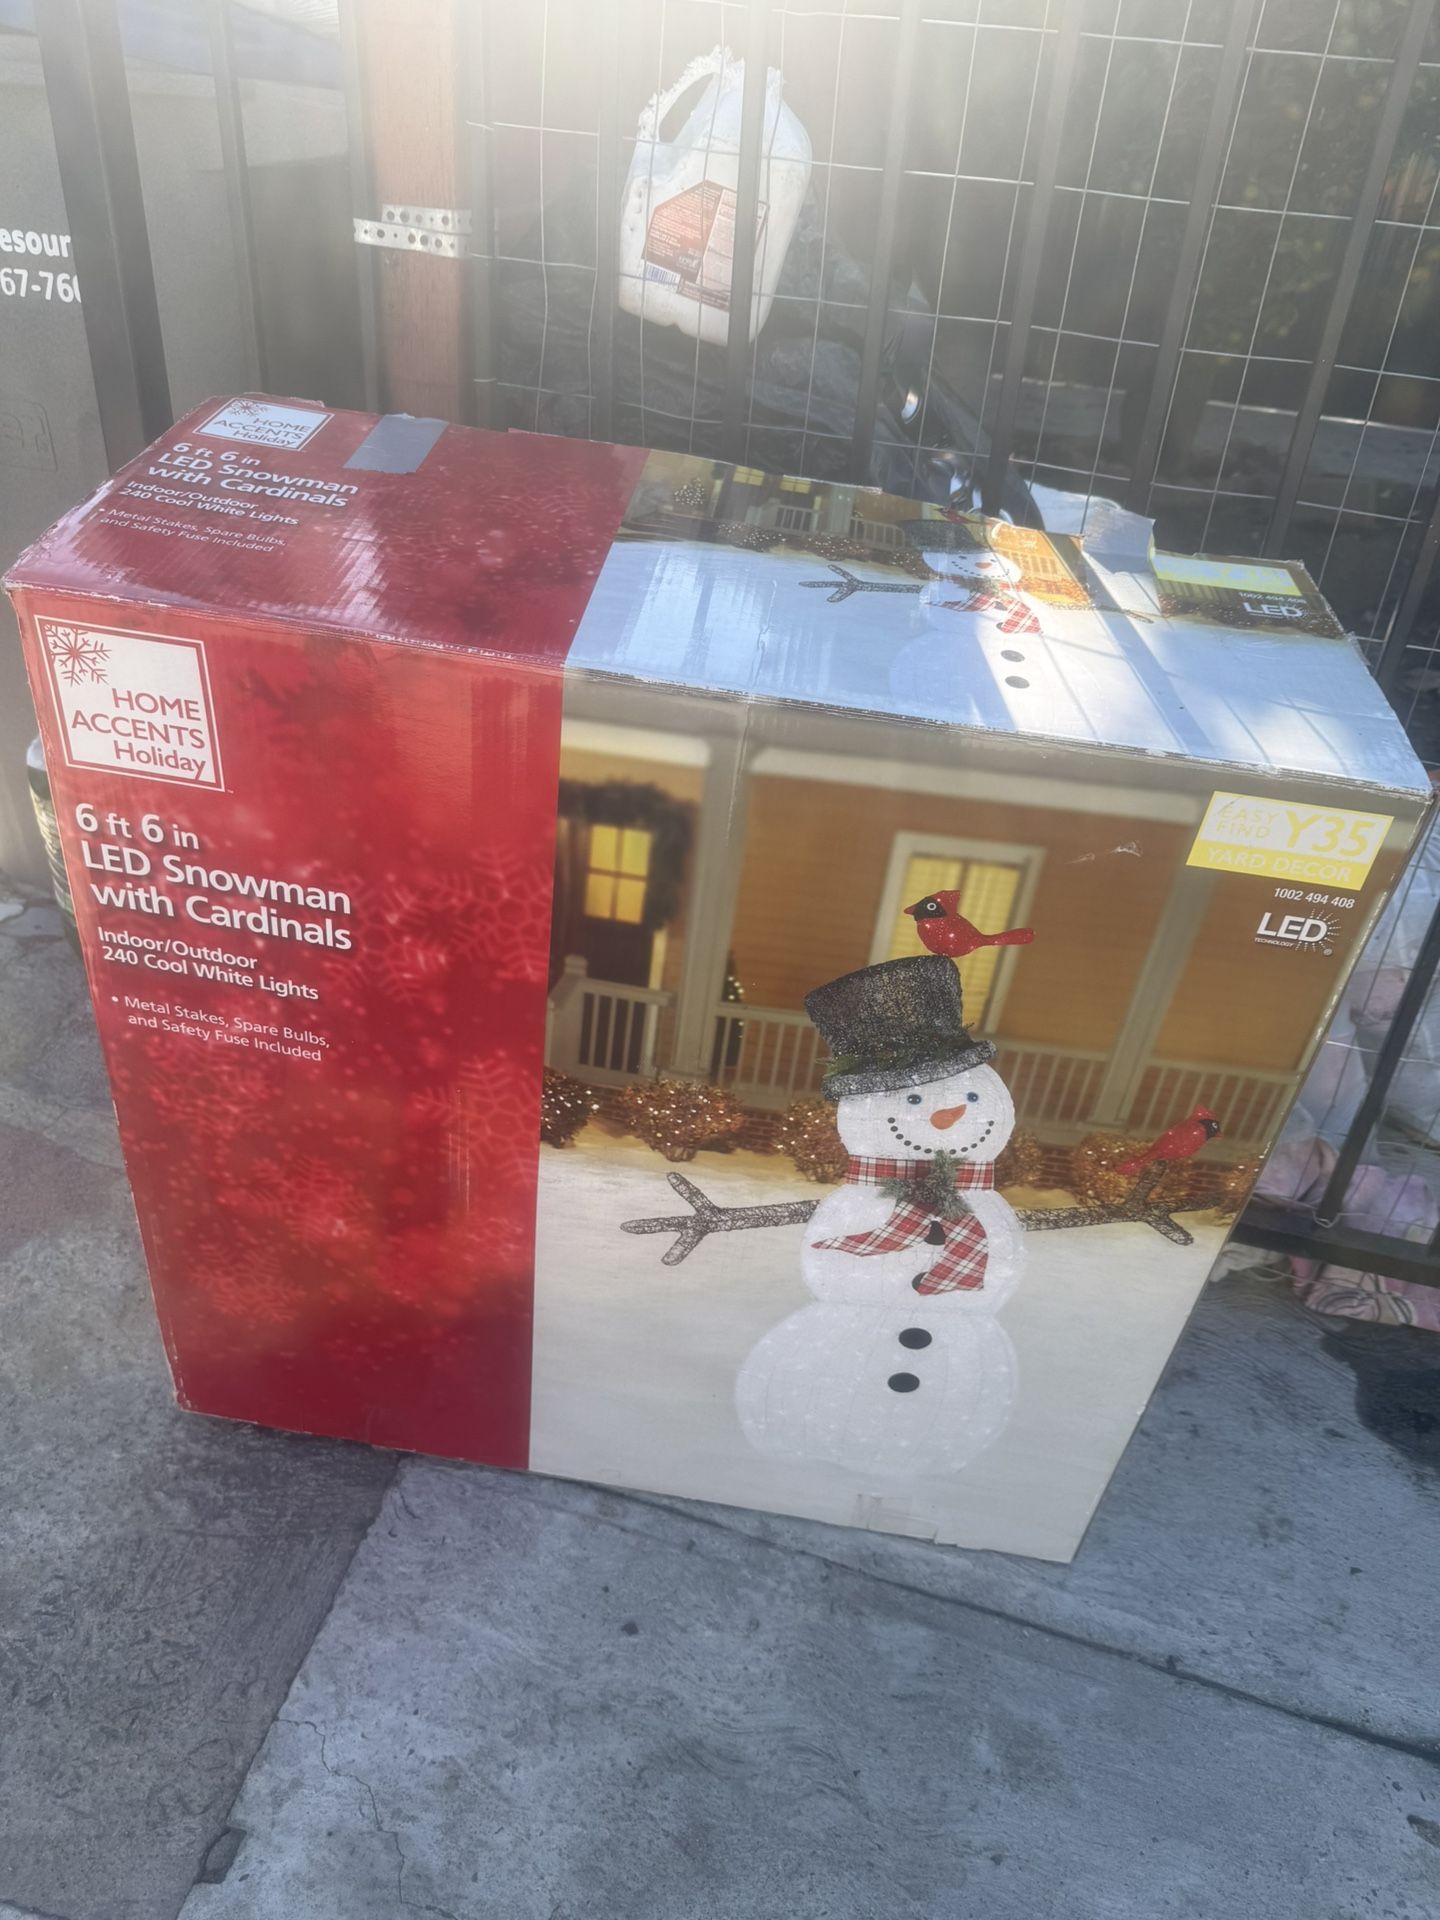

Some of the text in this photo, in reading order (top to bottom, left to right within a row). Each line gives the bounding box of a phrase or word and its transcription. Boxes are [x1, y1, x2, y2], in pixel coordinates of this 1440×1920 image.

[214, 419, 304, 440] ACCENTS
[233, 430, 297, 447] Holiday
[253, 418, 311, 432] HOME
[157, 453, 359, 495] LED Snowman
[173, 443, 261, 467] 6 ft 6 in
[127, 480, 259, 509] Indoor/Outdoor
[148, 466, 348, 507] with Cardinals
[119, 488, 299, 526] 240 Cool White Lights
[100, 517, 274, 552] and Safety Fuse Included
[108, 508, 287, 547] Metal Stakes, Spare Bulbs,
[1243, 602, 1302, 617] LED
[112, 687, 201, 721] HOME
[71, 709, 206, 750] ACCENTS
[113, 739, 207, 781] Holiday
[75, 802, 200, 850] 6 ft 6 in
[1215, 818, 1271, 840] FIND
[1220, 804, 1280, 824] EASY
[1285, 809, 1376, 858] Y35
[80, 840, 351, 914] LED Snowman
[1205, 847, 1351, 883] YARD DECOR
[89, 881, 352, 951] with Cardinals
[1274, 887, 1355, 909] 1002 494 408
[1256, 911, 1328, 942] LED
[97, 925, 257, 969] Indoor/Outdoor
[102, 945, 319, 1001] 240 Cool White Lights
[125, 995, 331, 1049] Metal Stakes, Spare Bulbs,
[128, 1013, 322, 1062] and Safety Fuse Included
